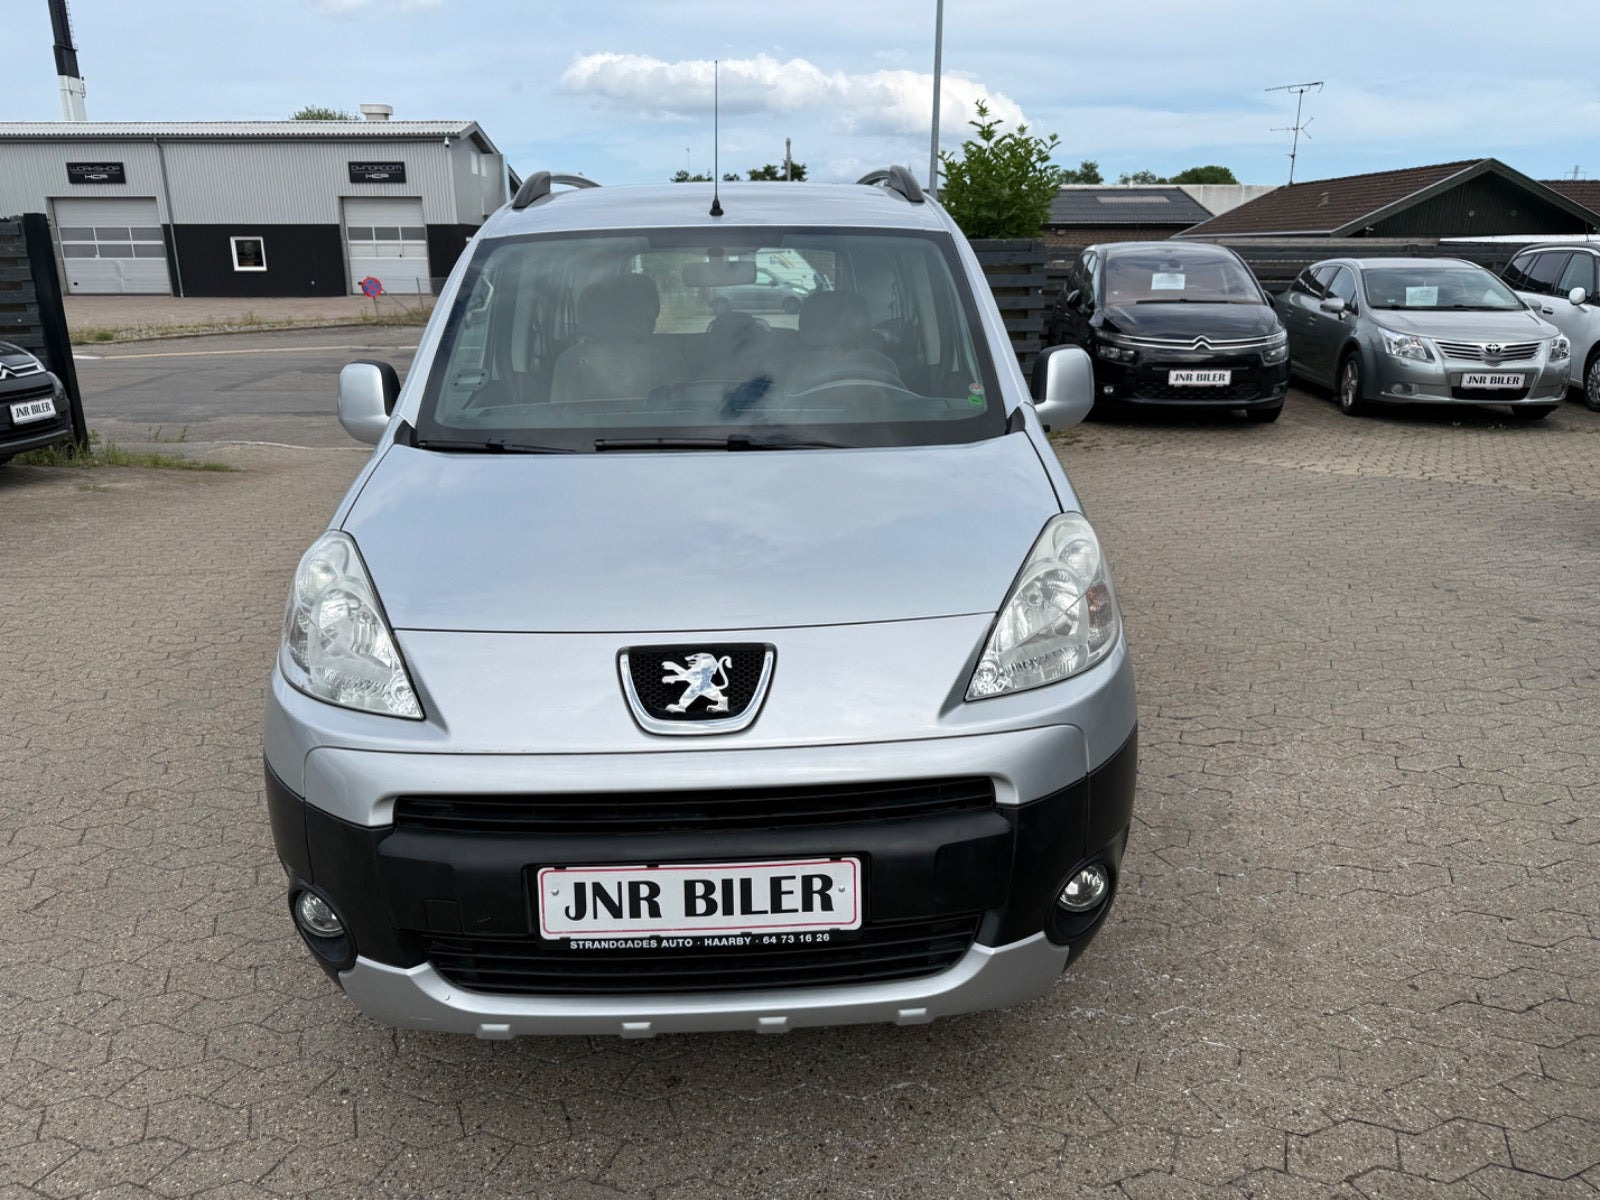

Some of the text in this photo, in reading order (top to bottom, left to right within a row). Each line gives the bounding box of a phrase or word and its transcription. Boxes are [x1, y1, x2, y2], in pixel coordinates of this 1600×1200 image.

[1174, 373, 1226, 382] JNR BILER
[1466, 376, 1520, 385] JNR BILER
[15, 402, 52, 418] JNR BILER
[564, 873, 835, 922] JNR BILER
[569, 932, 830, 950] STRANDGADES AUTO HAARBY 64 73 16 26
